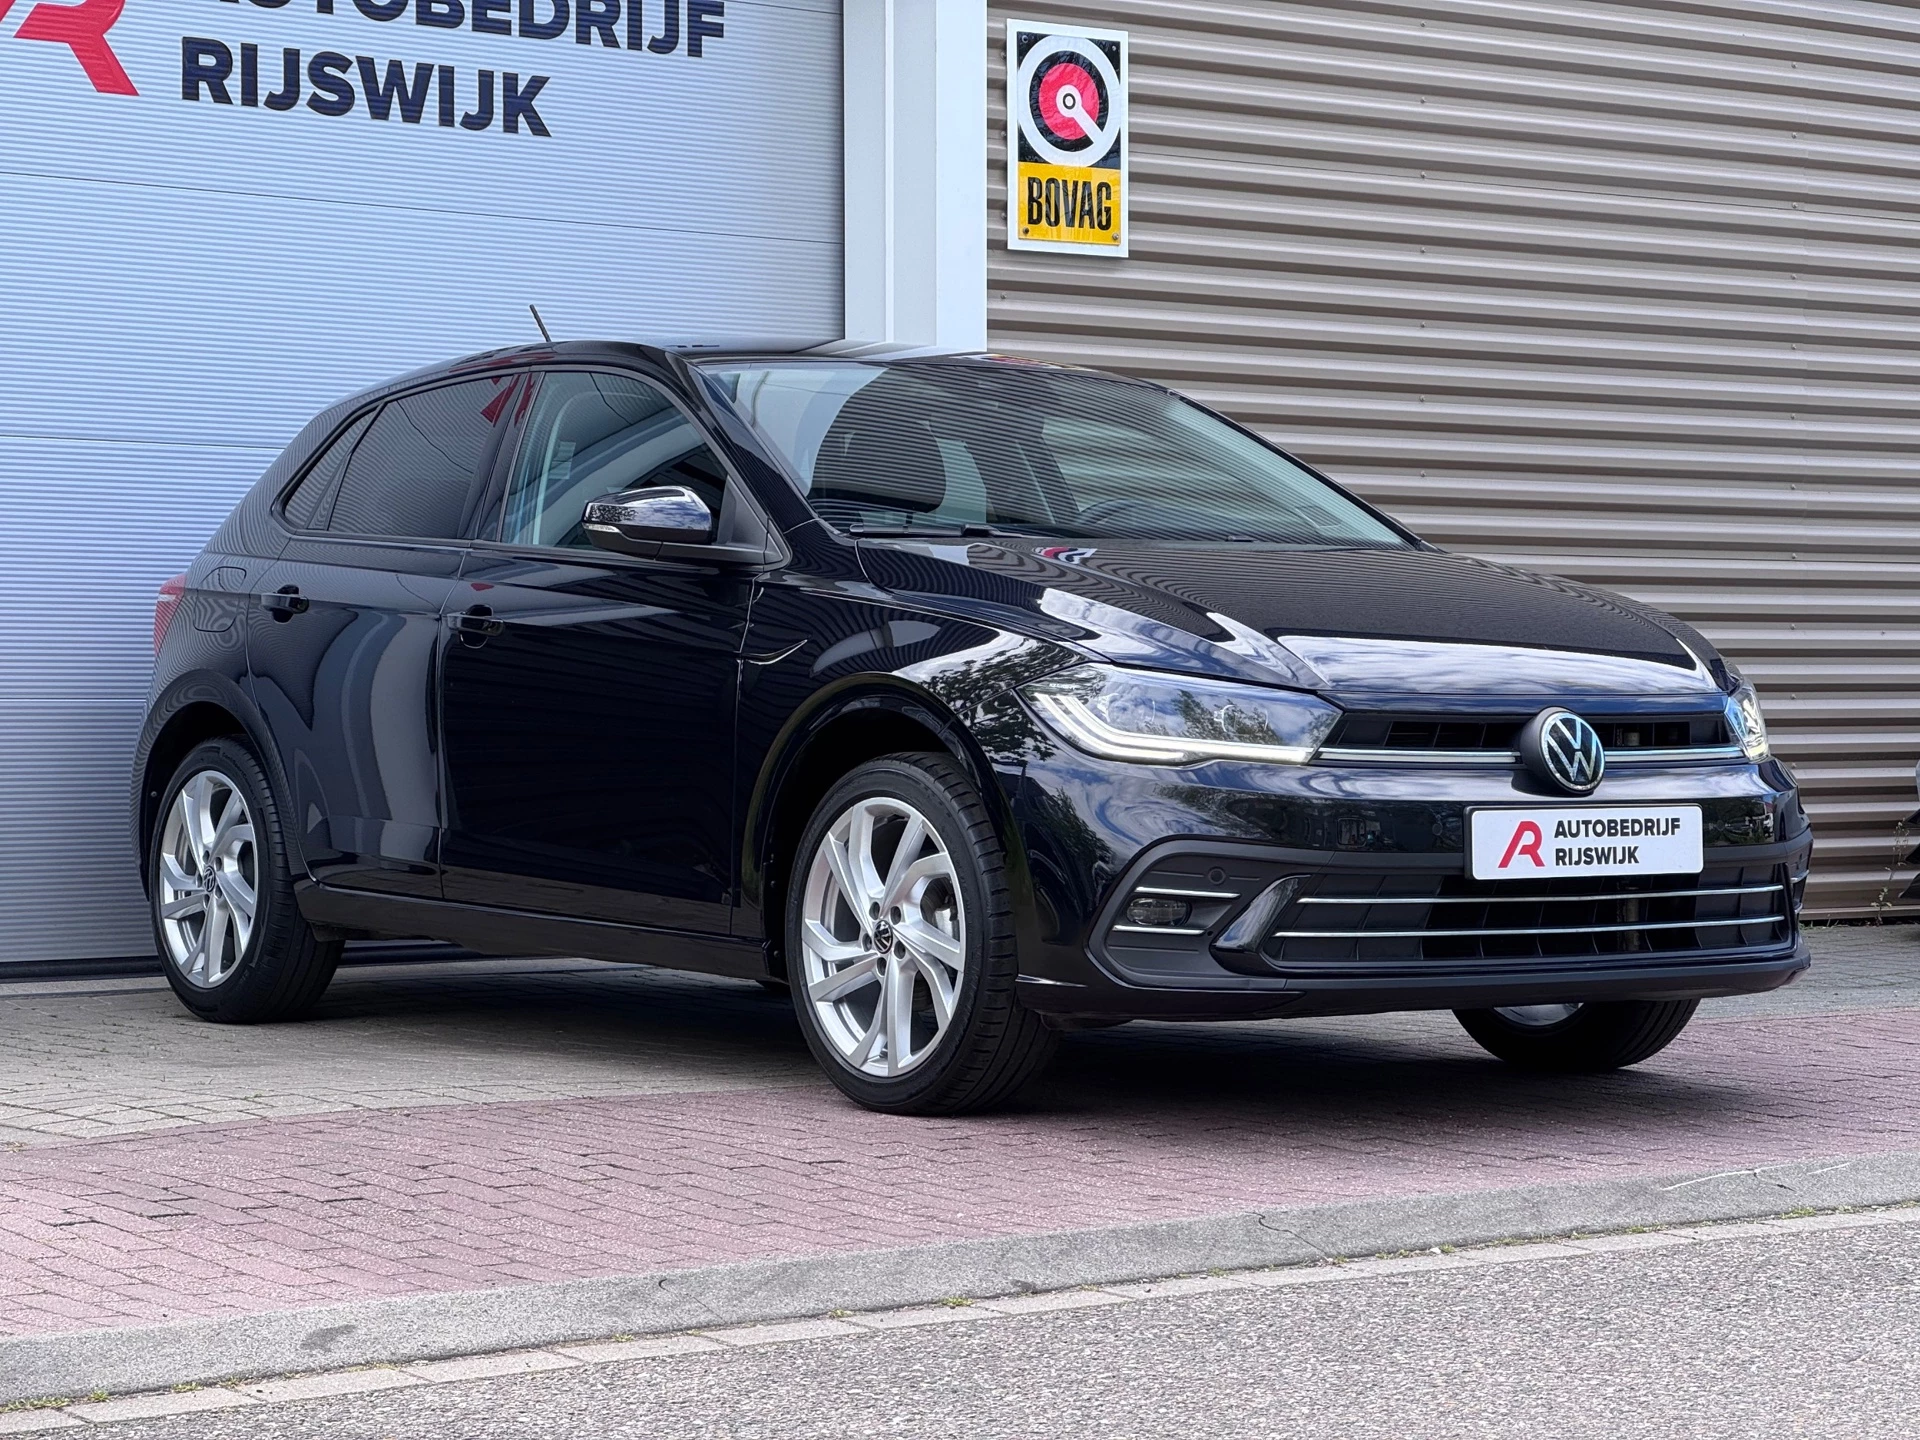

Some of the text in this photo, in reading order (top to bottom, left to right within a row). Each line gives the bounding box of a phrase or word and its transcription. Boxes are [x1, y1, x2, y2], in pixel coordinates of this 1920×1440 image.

[217, 0, 725, 57] EDRIJF
[182, 36, 552, 137] RIJSWIJK
[1027, 177, 1112, 230] BOVAG
[1554, 818, 1680, 838] AUTOBEDRIJF
[1555, 846, 1639, 866] RIJSWIJK
